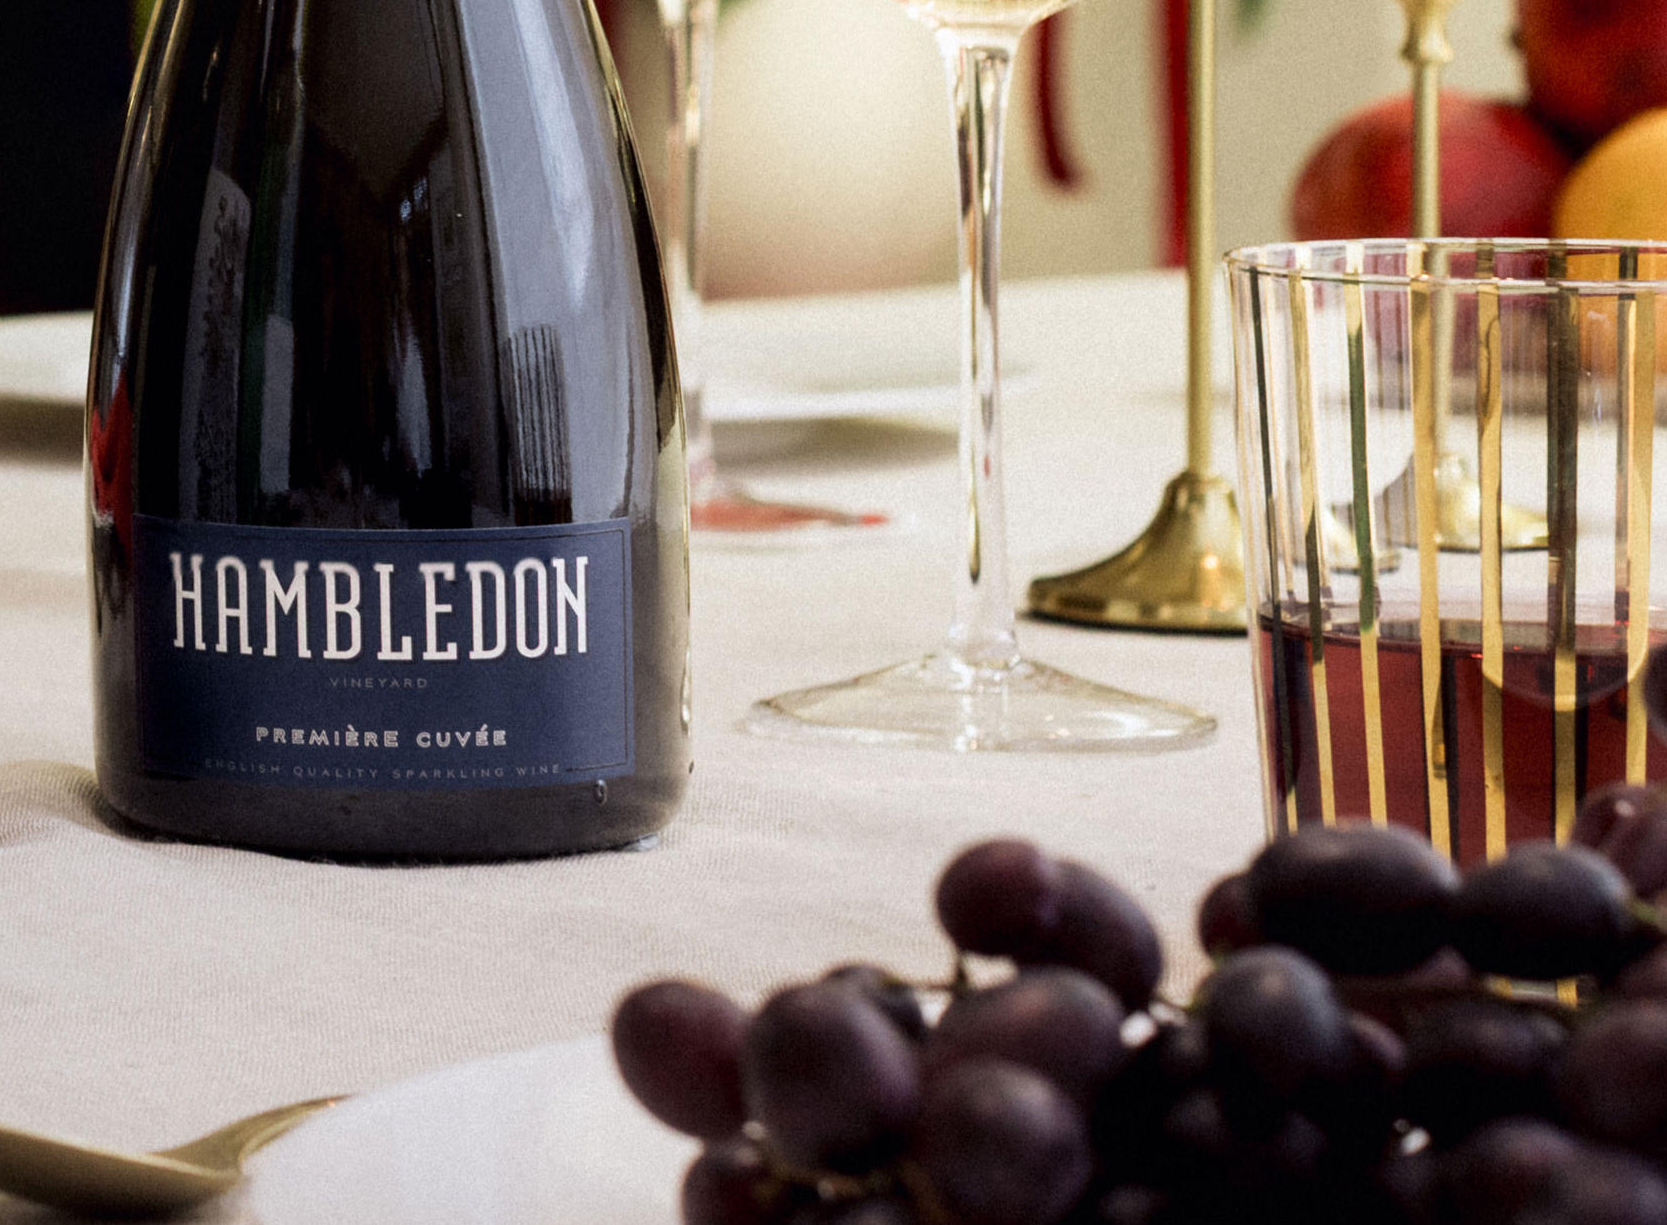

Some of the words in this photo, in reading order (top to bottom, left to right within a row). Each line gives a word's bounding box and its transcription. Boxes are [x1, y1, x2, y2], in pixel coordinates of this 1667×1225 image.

[170, 552, 589, 661] HAMBLEDON
[330, 676, 429, 689] VINEYARD
[256, 724, 399, 748] PREMIÈRE
[416, 724, 507, 748] CUVÉE
[204, 757, 281, 775] ENGLISH
[293, 766, 379, 779] QUALITY
[392, 766, 504, 780] SPARKLING
[516, 763, 561, 776] WINE
